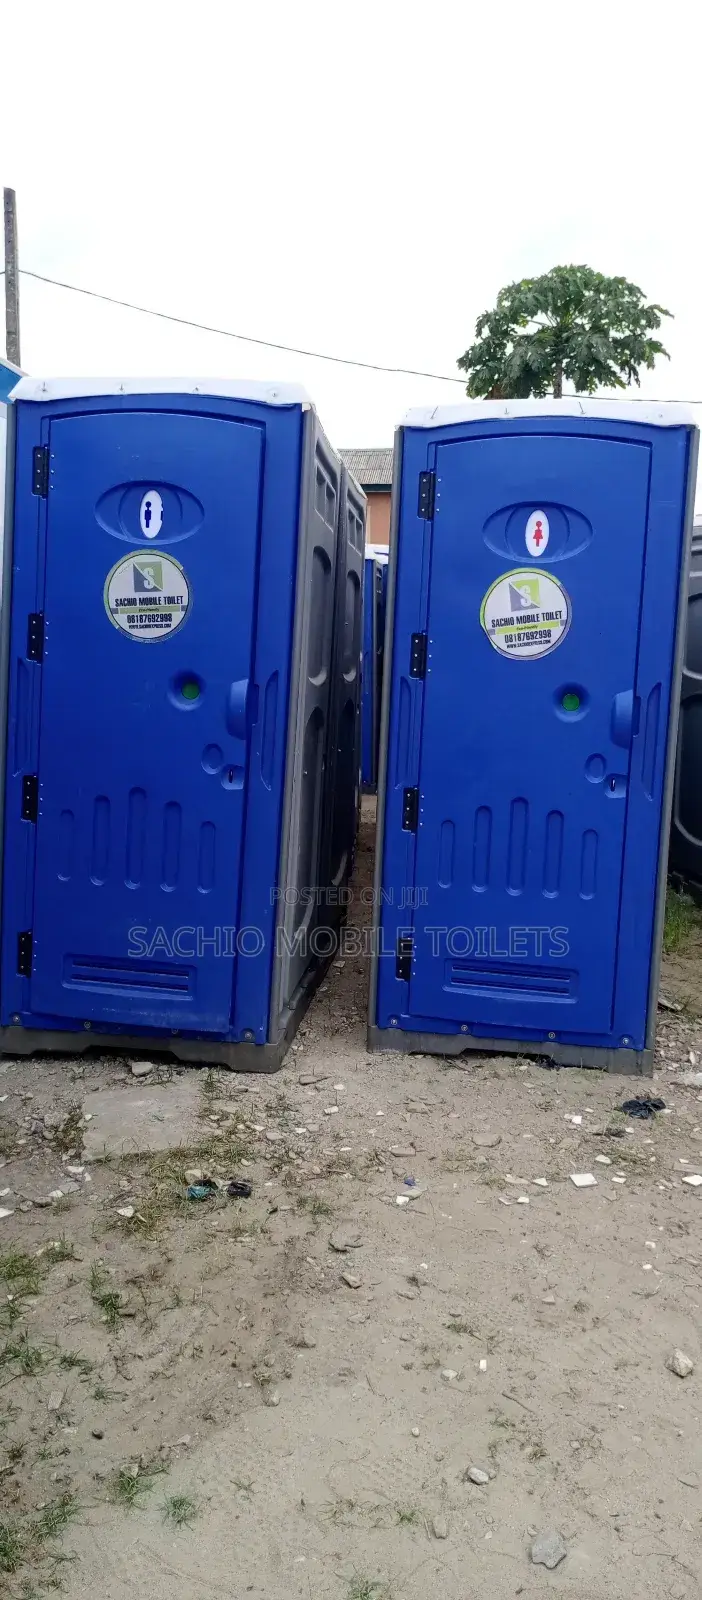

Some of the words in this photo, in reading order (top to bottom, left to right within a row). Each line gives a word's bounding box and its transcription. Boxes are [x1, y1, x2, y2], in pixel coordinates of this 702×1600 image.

[143, 567, 155, 590] S
[115, 597, 137, 607] SACHIO
[139, 596, 162, 606] MOBILE
[164, 595, 184, 605] TOILET
[520, 585, 532, 607] S
[491, 616, 514, 628] SACHIO
[516, 613, 540, 625] MOBILE
[541, 610, 562, 621] TOILET
[504, 629, 552, 643] 08187692998
